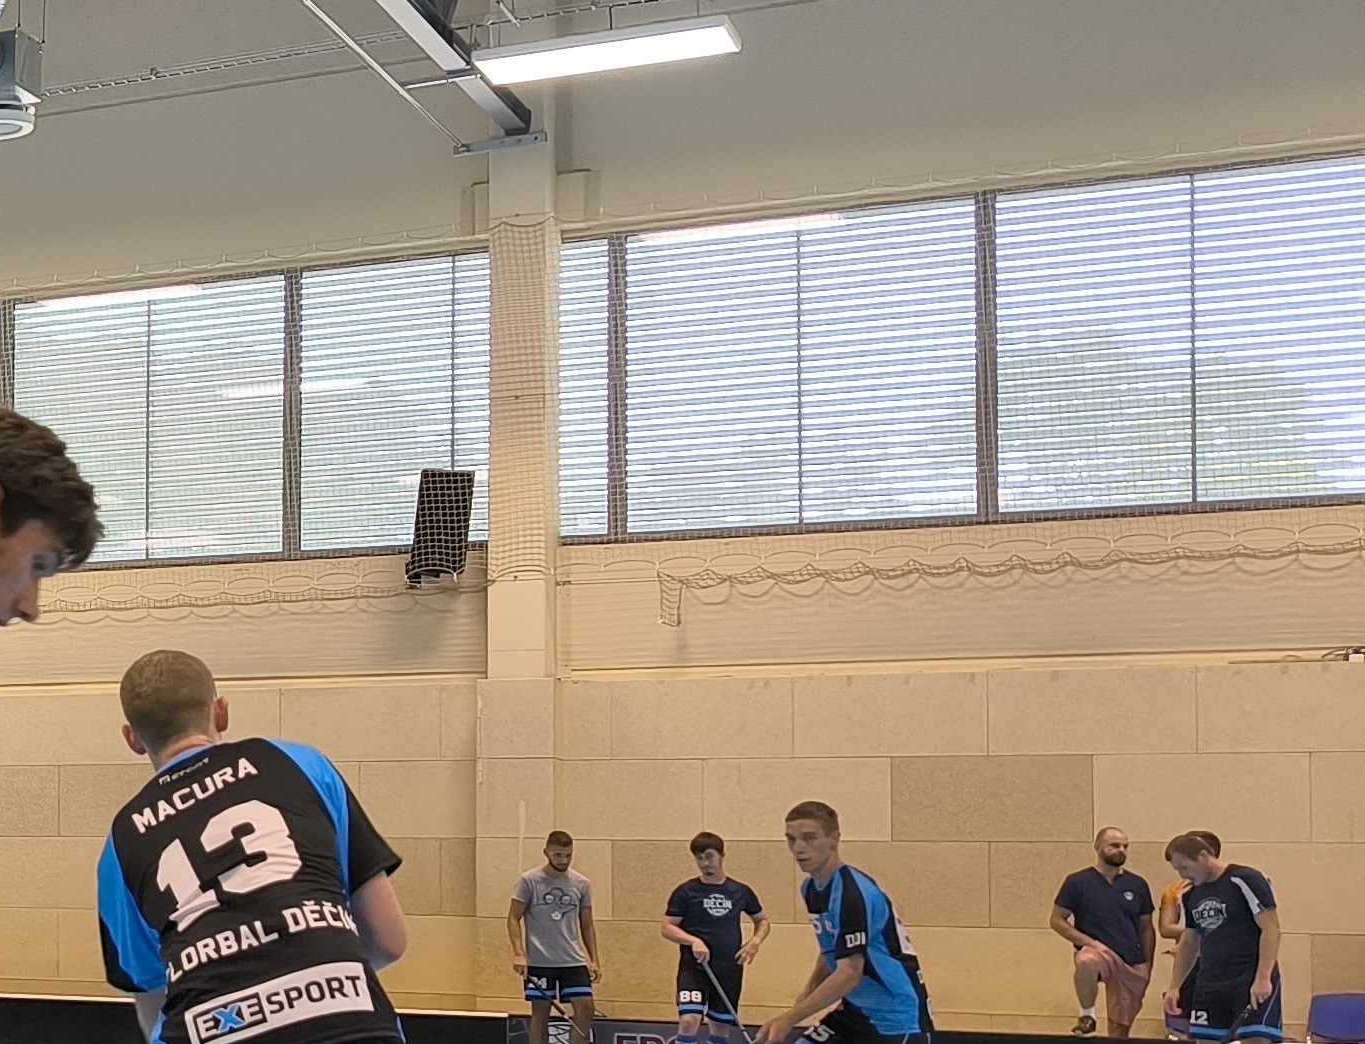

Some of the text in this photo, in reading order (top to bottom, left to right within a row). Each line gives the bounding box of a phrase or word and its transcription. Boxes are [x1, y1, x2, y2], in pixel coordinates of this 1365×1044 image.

[131, 757, 259, 834] MACURA
[156, 799, 302, 933] 13
[166, 920, 280, 983] LORBAL
[1189, 1009, 1209, 1025] 12
